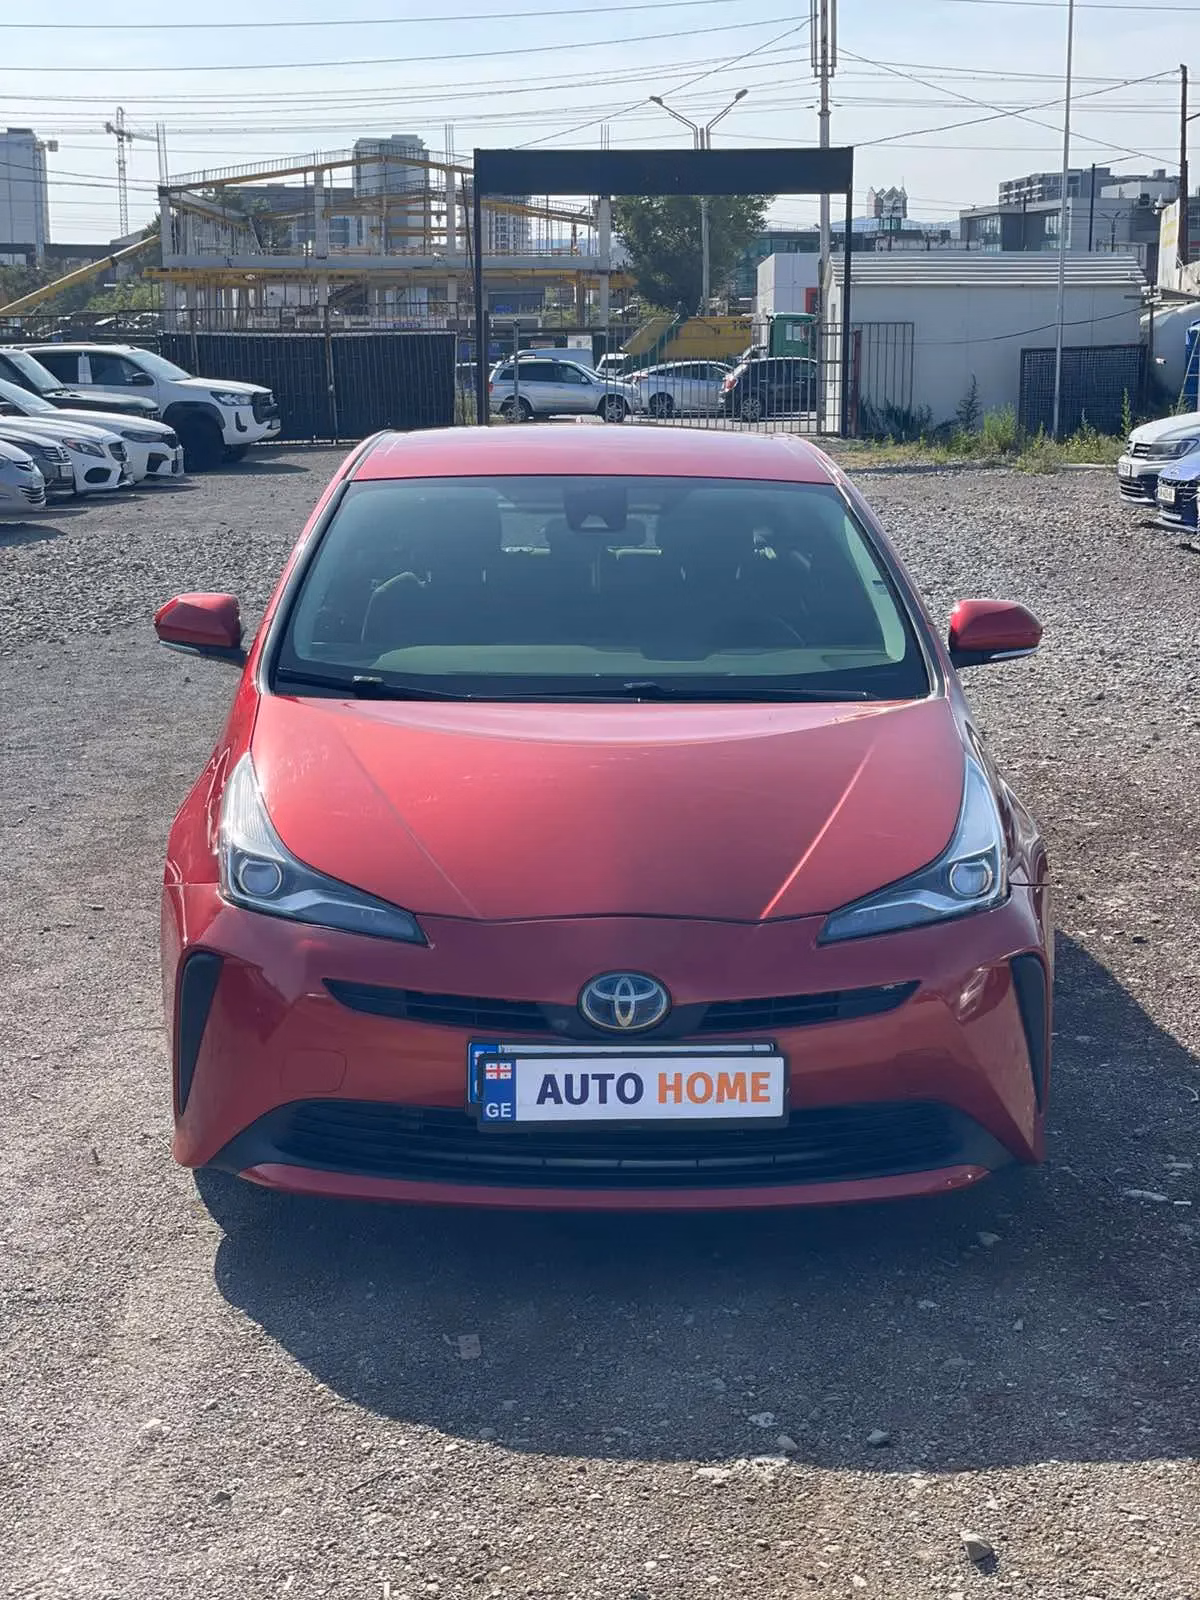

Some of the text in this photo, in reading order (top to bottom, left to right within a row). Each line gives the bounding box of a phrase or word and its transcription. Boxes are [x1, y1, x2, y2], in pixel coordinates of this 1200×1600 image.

[536, 1071, 771, 1105] AUTO HOME
[485, 1102, 512, 1118] GE
